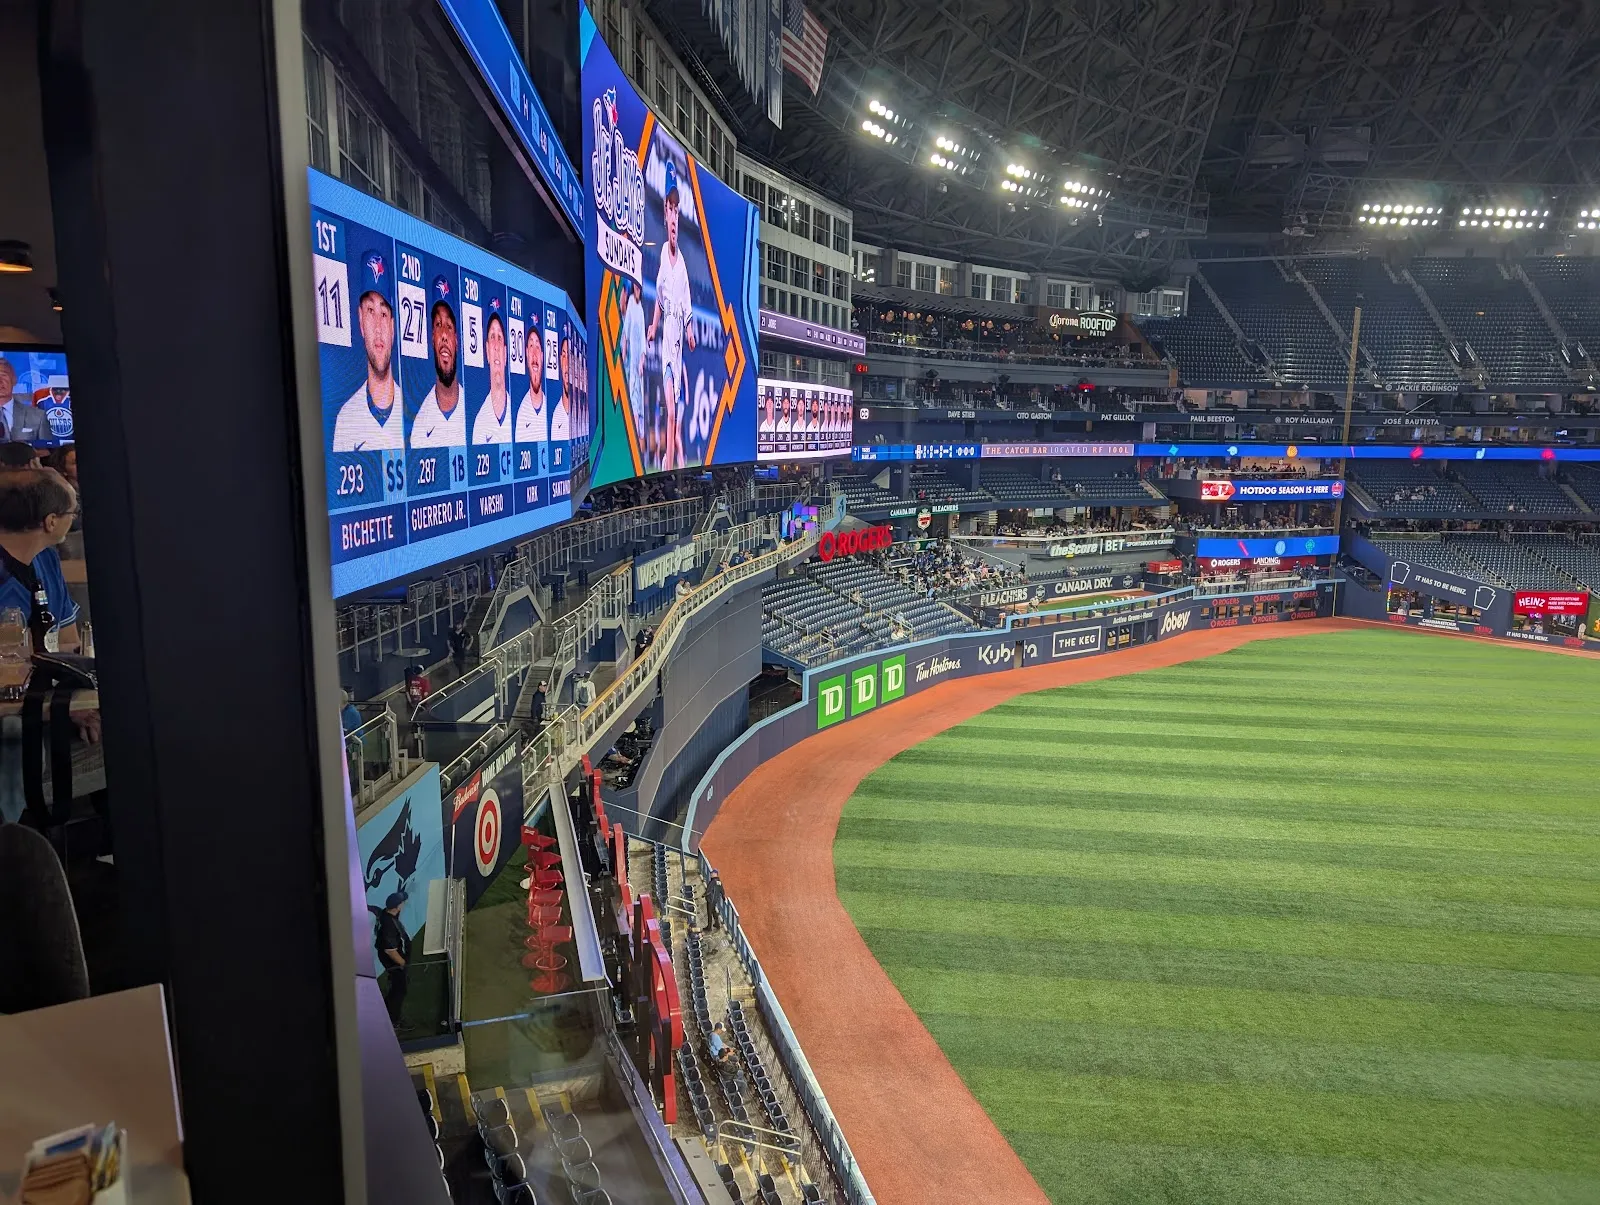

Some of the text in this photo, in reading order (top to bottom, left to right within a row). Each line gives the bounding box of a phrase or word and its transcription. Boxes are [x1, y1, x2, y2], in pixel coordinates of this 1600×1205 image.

[316, 219, 337, 254] 1ST
[604, 231, 635, 273] SUNDAYS
[401, 252, 421, 282] 2ND
[318, 276, 343, 328] 11
[464, 277, 478, 302] 3RD
[510, 296, 522, 317] 4TH
[546, 310, 556, 328] 5TH
[401, 296, 424, 344] 27
[1049, 313, 1116, 332] Corona ROOFTOP
[469, 316, 478, 354] 5
[510, 328, 523, 363] 30
[546, 339, 558, 370] 25
[758, 396, 766, 408] 30
[775, 396, 782, 408] 25
[1383, 416, 1402, 424] JOSÉ
[418, 454, 465, 484] .287 1B
[476, 450, 511, 476] .229 CF
[541, 448, 546, 469] C
[337, 459, 404, 496] .293 SS
[1240, 486, 1277, 494] HOTDOG
[480, 493, 504, 516] VARSHO
[526, 485, 538, 503] KIRK
[411, 500, 466, 531] GUERRERO JR.
[341, 515, 393, 550] BICHETTE
[838, 525, 893, 556] ROGERS
[1051, 543, 1098, 557] theScore
[1105, 539, 1125, 552] BET
[636, 552, 676, 590] WESTJET
[1253, 557, 1280, 565] LANDING
[1055, 578, 1092, 594] CANADA
[1421, 576, 1433, 585] HAS
[1295, 610, 1317, 618] ROGERS
[1519, 597, 1546, 607] HEINZ
[1160, 610, 1191, 635] Sobeys
[1216, 619, 1238, 627] ROGERS
[1058, 636, 1095, 648] THE KEG
[885, 664, 902, 692] TD
[916, 658, 960, 682] Tim Hortons
[821, 685, 843, 716] TD
[855, 674, 874, 704] TD
[454, 780, 480, 812] Budweiser
